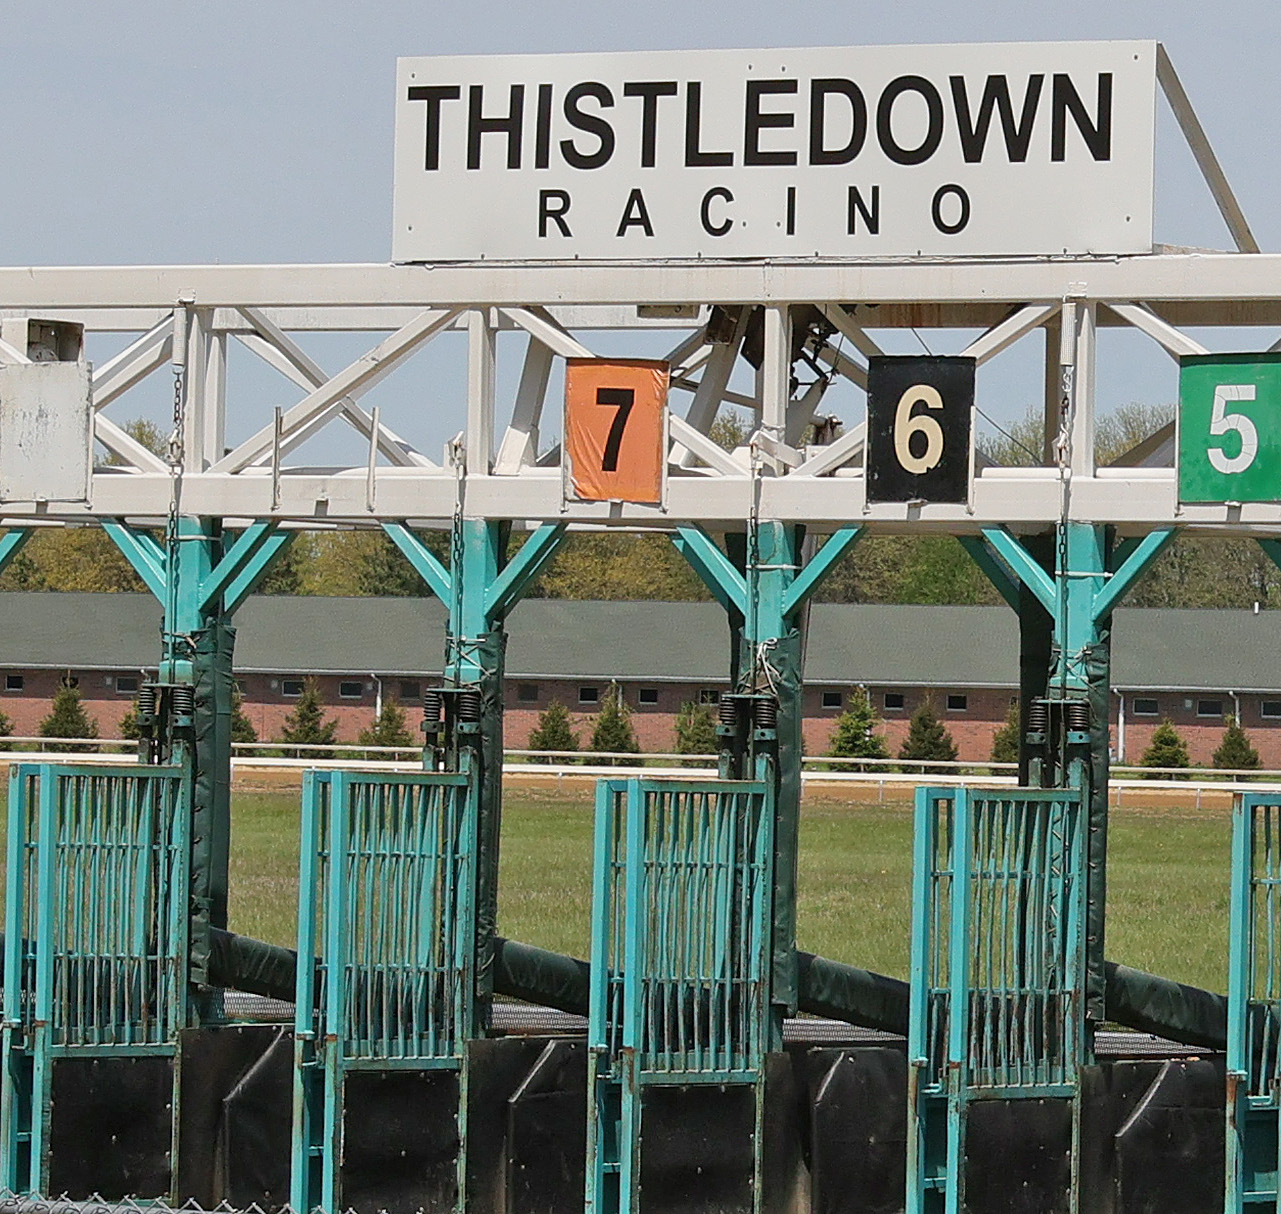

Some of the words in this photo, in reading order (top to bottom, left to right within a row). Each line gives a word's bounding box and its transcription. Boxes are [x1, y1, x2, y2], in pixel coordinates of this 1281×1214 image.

[407, 72, 1113, 170] THISTLEDOWN
[538, 183, 971, 238] RACINO
[595, 387, 635, 472] 7
[893, 384, 944, 474] 6
[1207, 384, 1259, 474] 5
